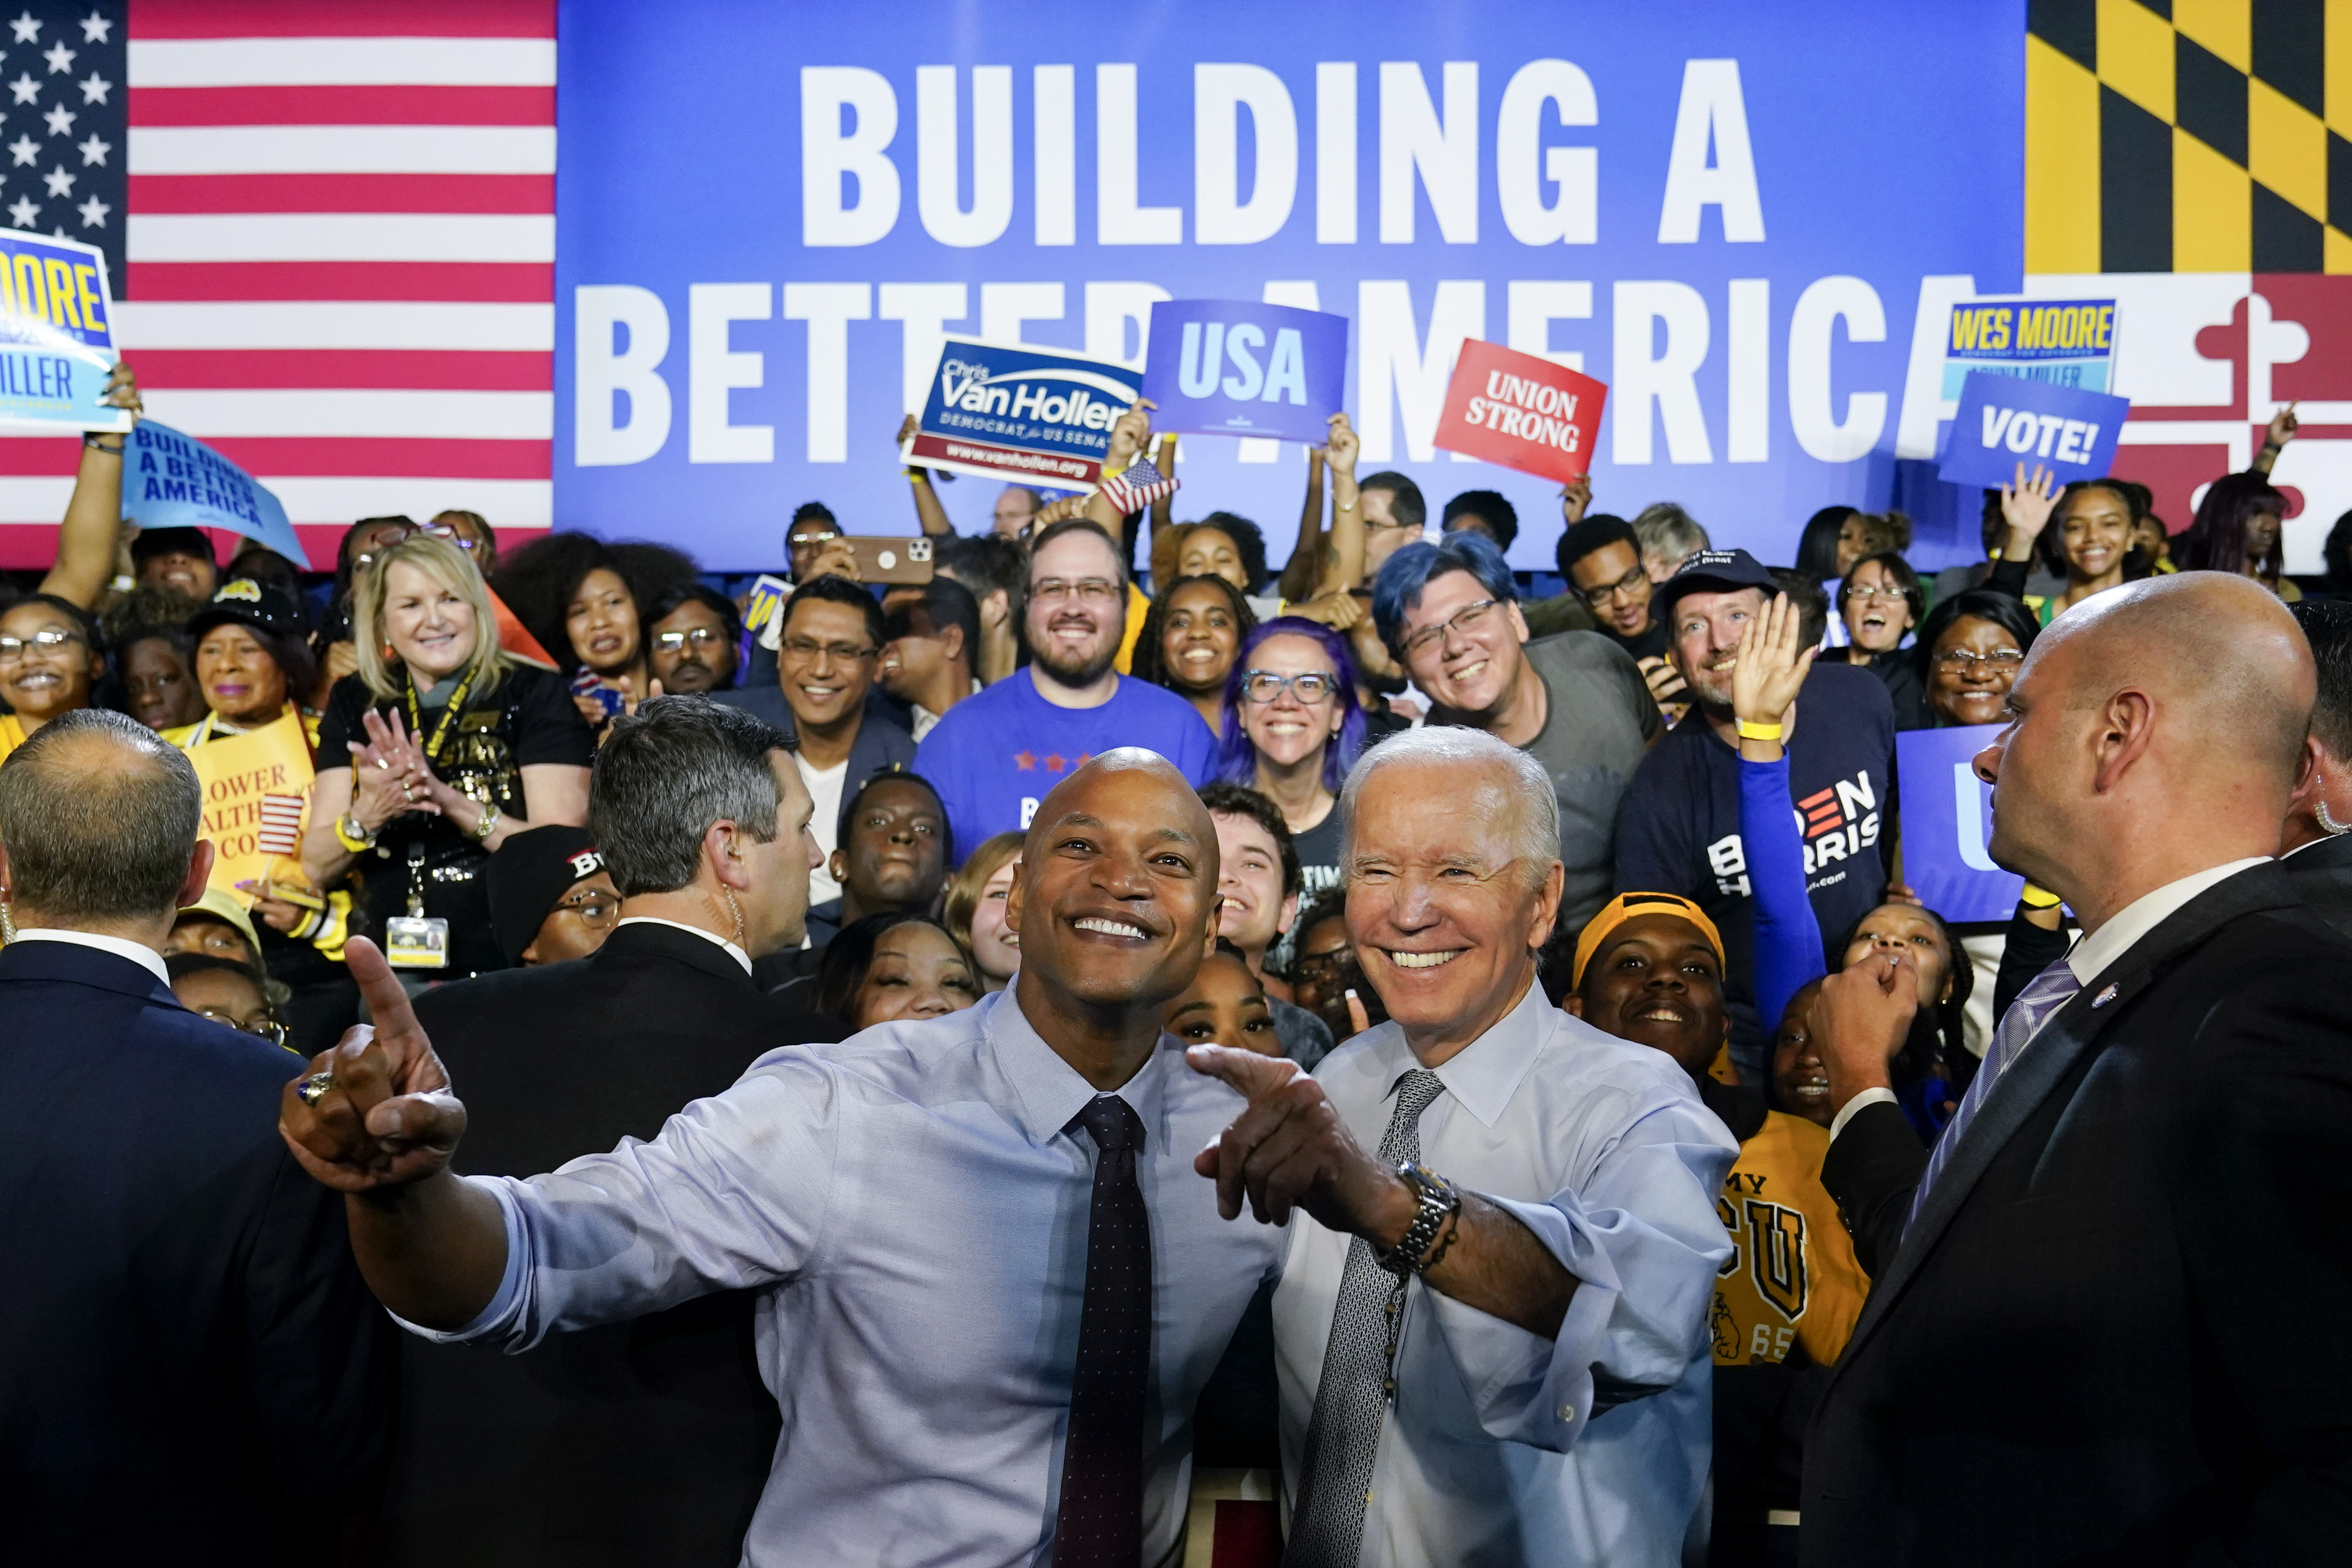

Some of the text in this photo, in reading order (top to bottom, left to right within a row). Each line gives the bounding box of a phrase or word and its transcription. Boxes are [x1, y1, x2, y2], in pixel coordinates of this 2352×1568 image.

[801, 58, 1766, 248] BUILDING A
[1952, 305, 2114, 350] WES MOORE
[942, 358, 990, 381] Chris
[1178, 322, 1307, 406] USA
[1238, 275, 1976, 463] MRIC
[941, 374, 1011, 417] Van
[1486, 370, 1579, 422] UNION
[939, 411, 1026, 439] DEMOCRAT
[1064, 429, 1112, 450] SENA
[1464, 396, 1580, 453] STRONG
[1982, 404, 2100, 465] VOTE!
[139, 451, 257, 506] A BETTER
[946, 443, 1088, 479] www.vanhollen.org
[144, 477, 263, 527] AMERICA
[1707, 769, 1876, 877] BEN
[1717, 811, 1880, 898] HRRIS
